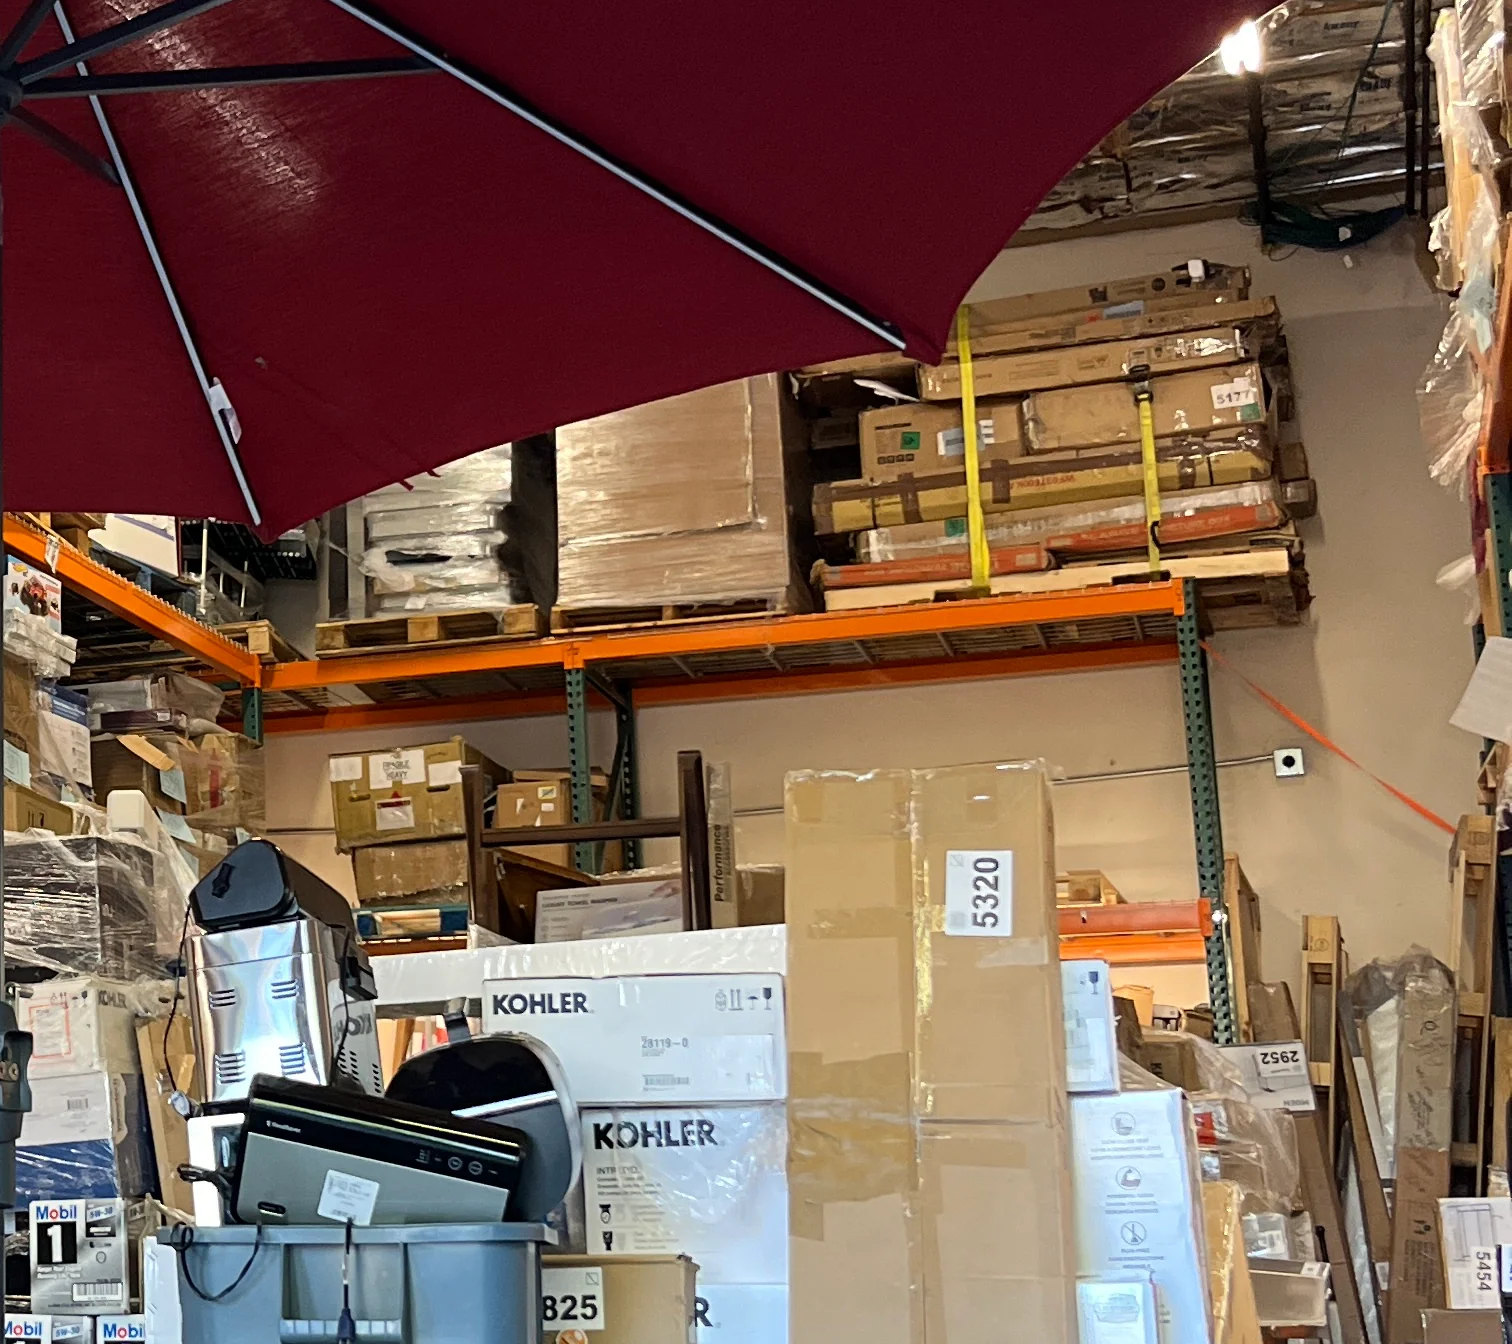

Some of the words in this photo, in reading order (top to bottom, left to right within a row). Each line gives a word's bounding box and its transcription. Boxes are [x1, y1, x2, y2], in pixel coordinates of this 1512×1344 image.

[713, 824, 724, 902] Performance
[971, 856, 1000, 929] 5320
[492, 992, 588, 1015] KOHLER
[1260, 1050, 1300, 1064] 2952
[593, 1119, 719, 1150] KOHLER
[37, 1205, 77, 1221] Mobil
[47, 1225, 62, 1263] 1
[1476, 1250, 1492, 1292] 5454
